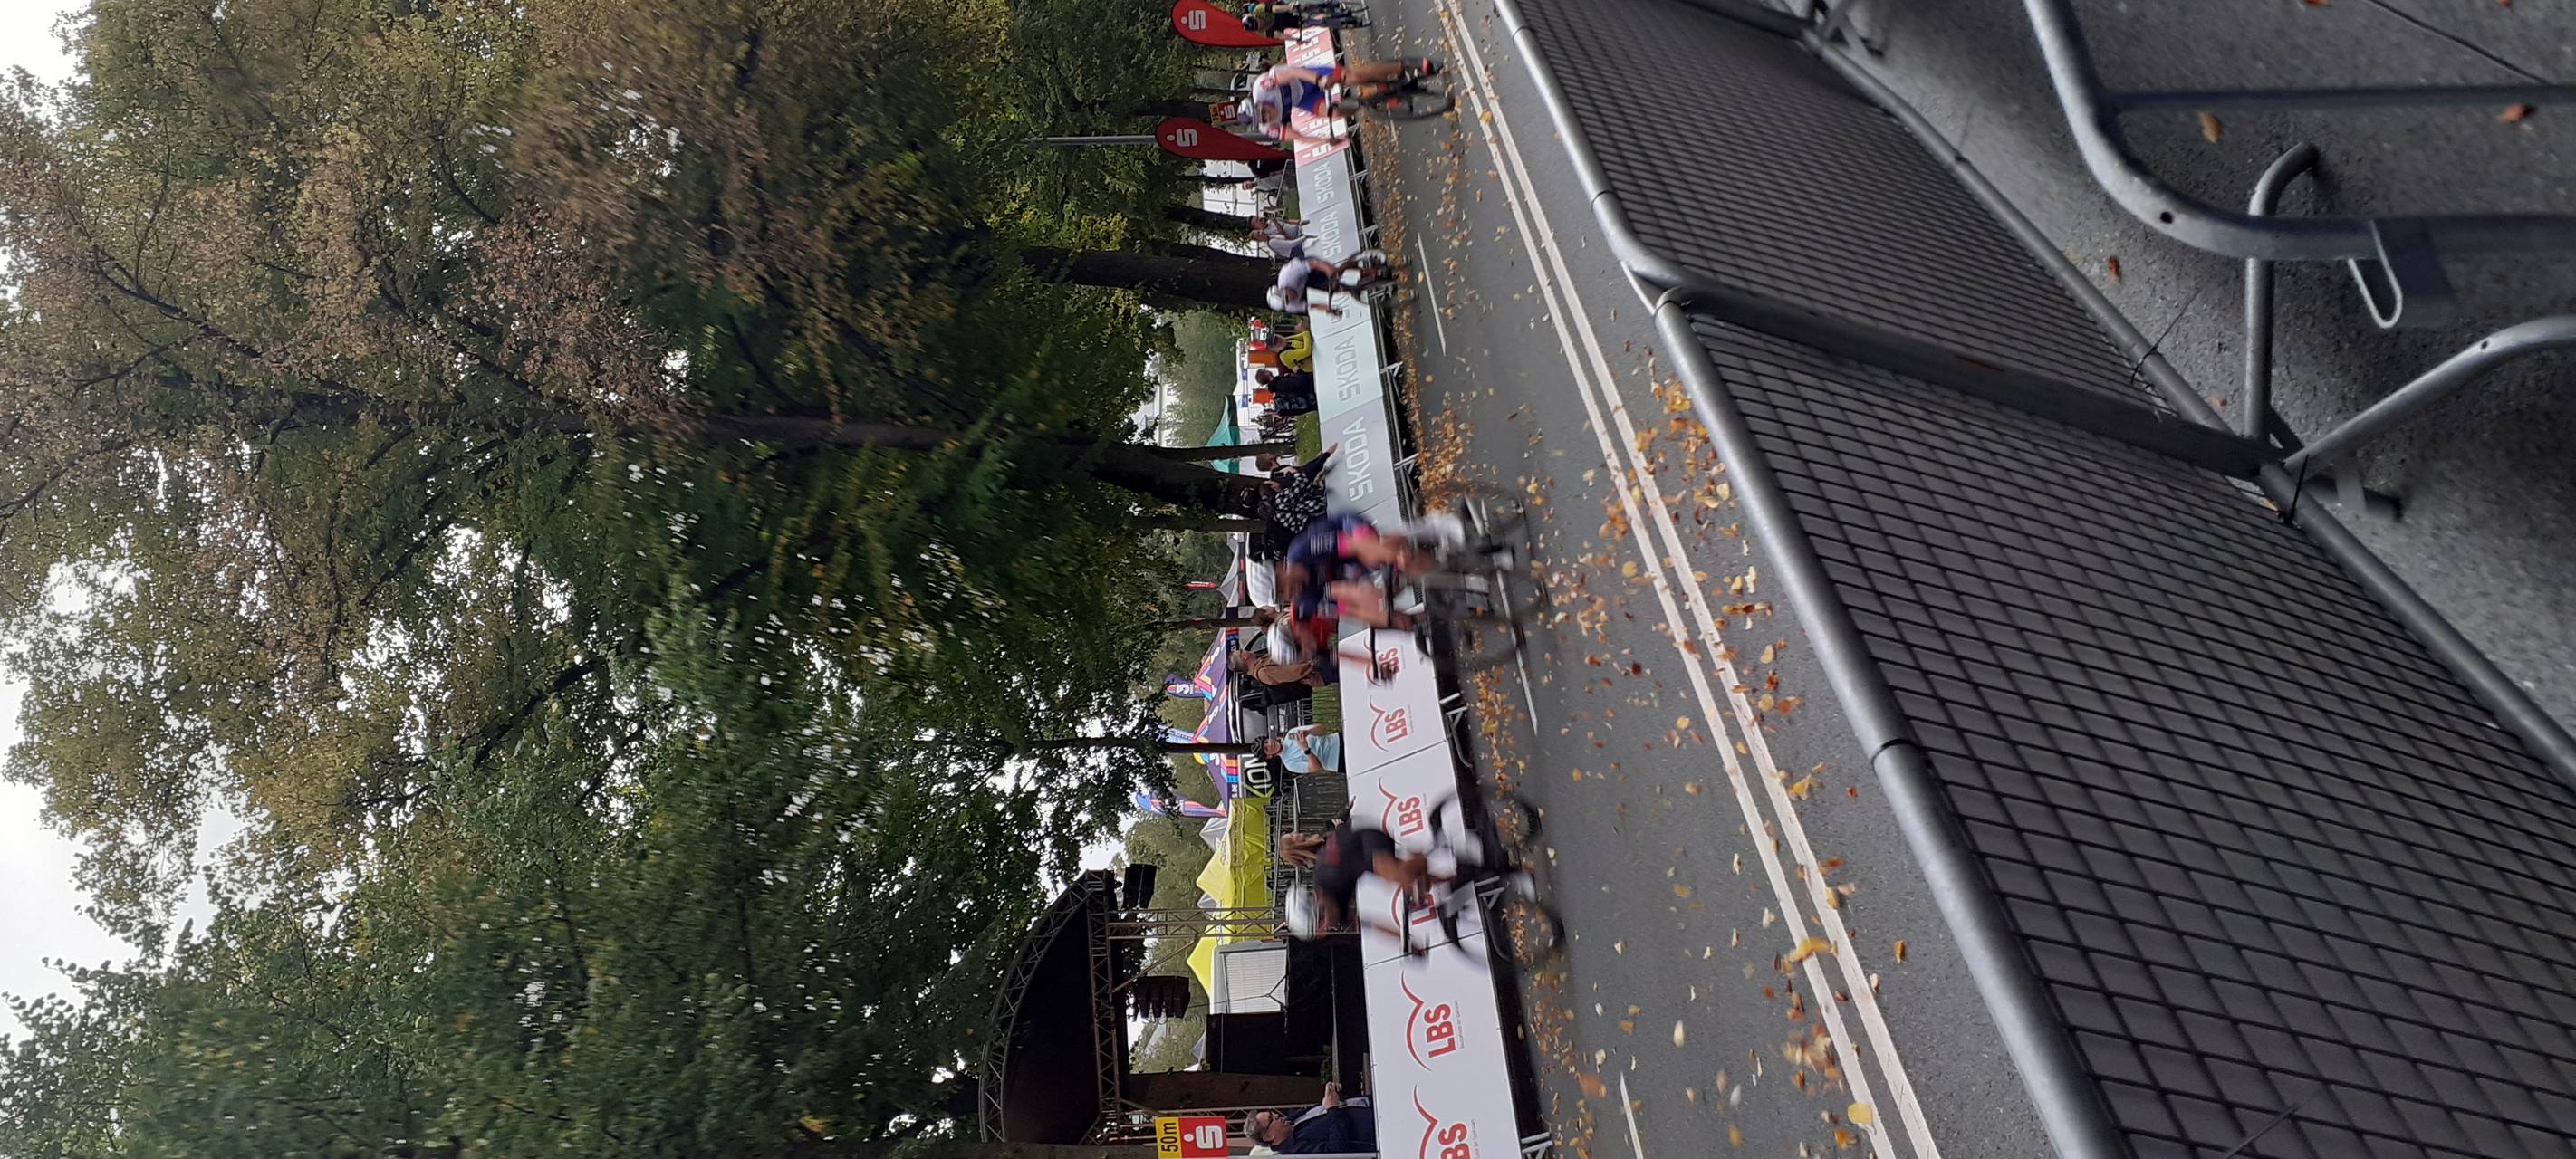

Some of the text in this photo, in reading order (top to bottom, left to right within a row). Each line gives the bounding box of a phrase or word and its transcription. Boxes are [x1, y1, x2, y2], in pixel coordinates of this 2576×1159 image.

[1384, 708, 1408, 743] LBS
[1397, 796, 1424, 837] LBS
[1423, 1002, 1456, 1058] LBS
[1437, 1122, 1472, 1159] BS
